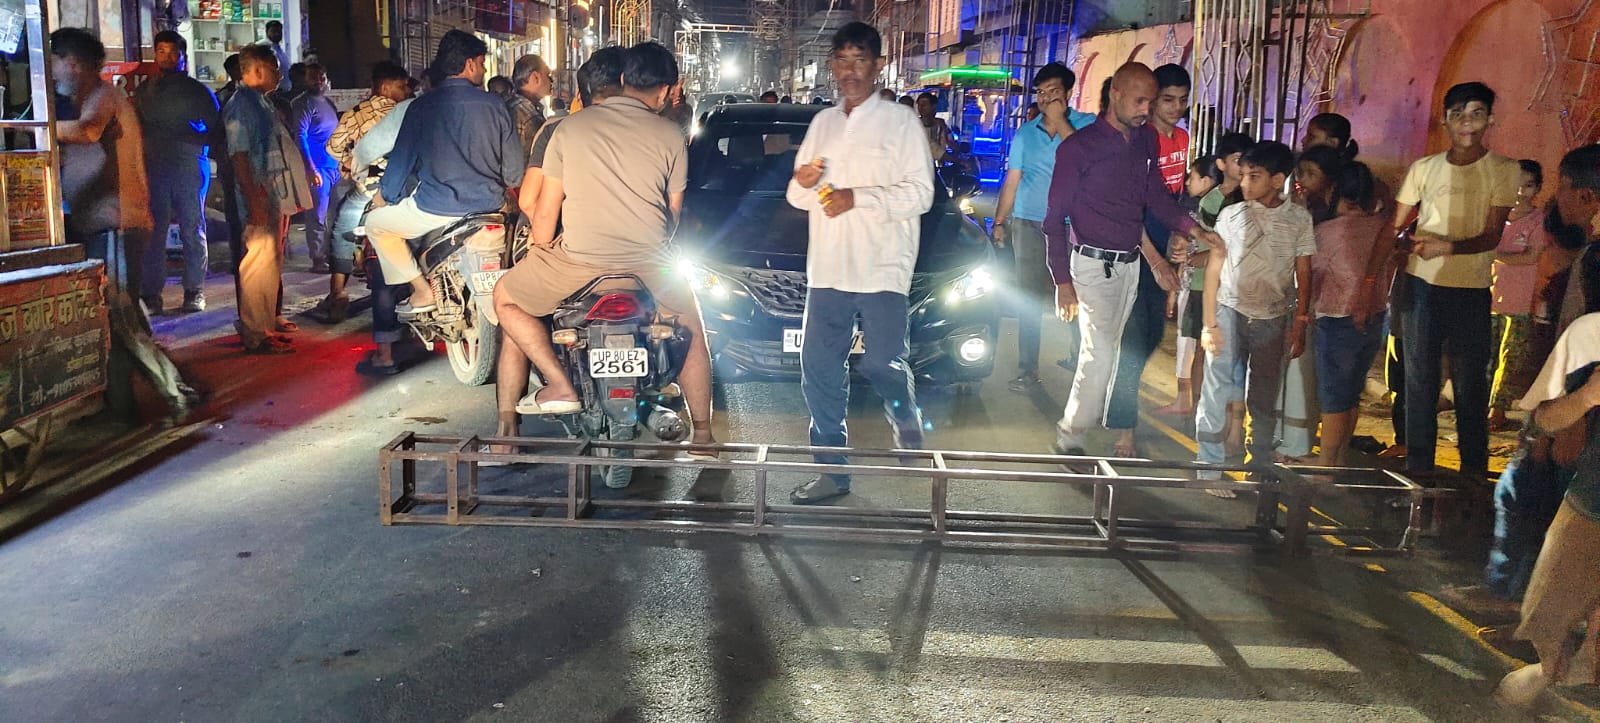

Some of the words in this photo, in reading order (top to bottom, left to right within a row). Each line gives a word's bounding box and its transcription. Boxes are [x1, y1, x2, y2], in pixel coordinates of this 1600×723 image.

[598, 351, 611, 361] UP
[614, 351, 625, 361] 80
[627, 350, 640, 361] EZ
[593, 360, 646, 374] 2561
